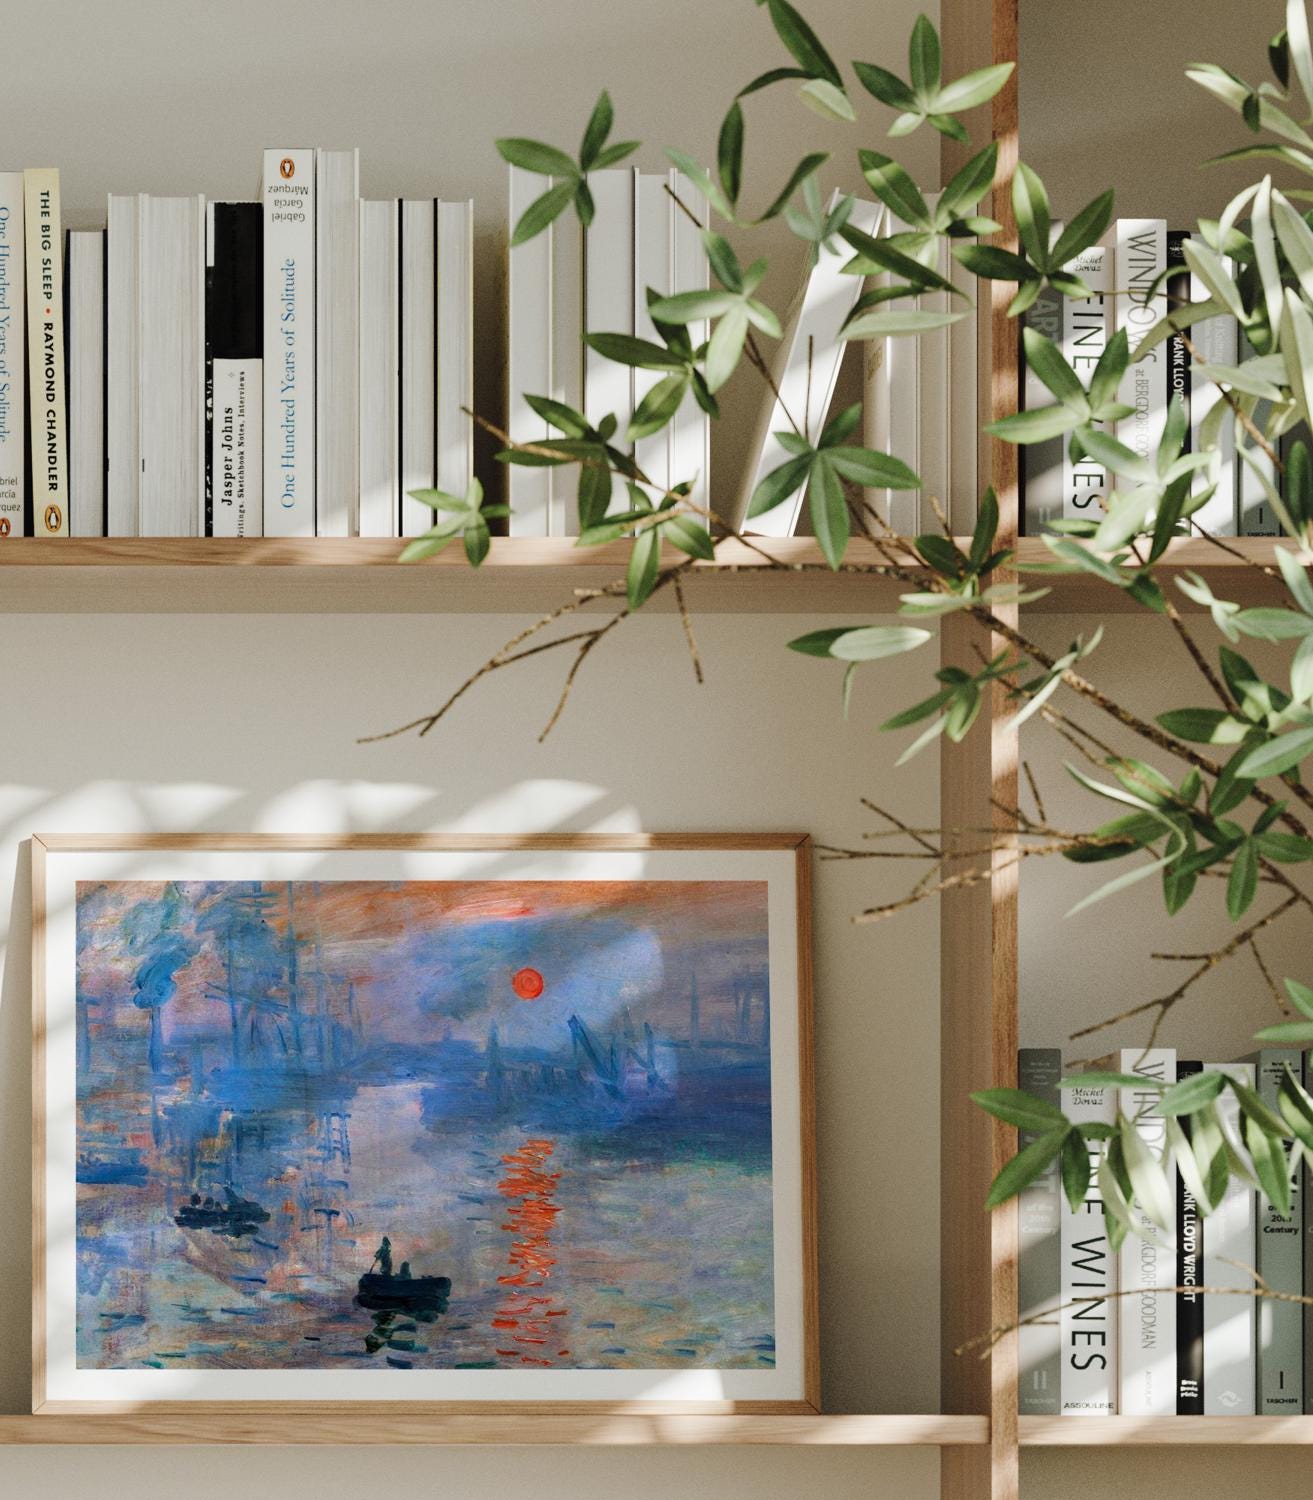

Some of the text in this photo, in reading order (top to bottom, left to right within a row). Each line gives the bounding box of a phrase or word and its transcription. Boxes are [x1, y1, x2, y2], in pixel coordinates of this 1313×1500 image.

[271, 213, 306, 223] Gabriel
[40, 190, 58, 491] THE BIG SLEEP RAYMOND CHANDLER
[236, 371, 245, 418] Interviews
[281, 258, 296, 509] One Hundred Years of Solitude
[221, 407, 234, 507] Jasper Johns
[235, 449, 245, 499] Sketchbook
[1183, 1214, 1196, 1252] LLOYD
[1263, 1226, 1299, 1235] Century
[1070, 1236, 1107, 1371] WINES
